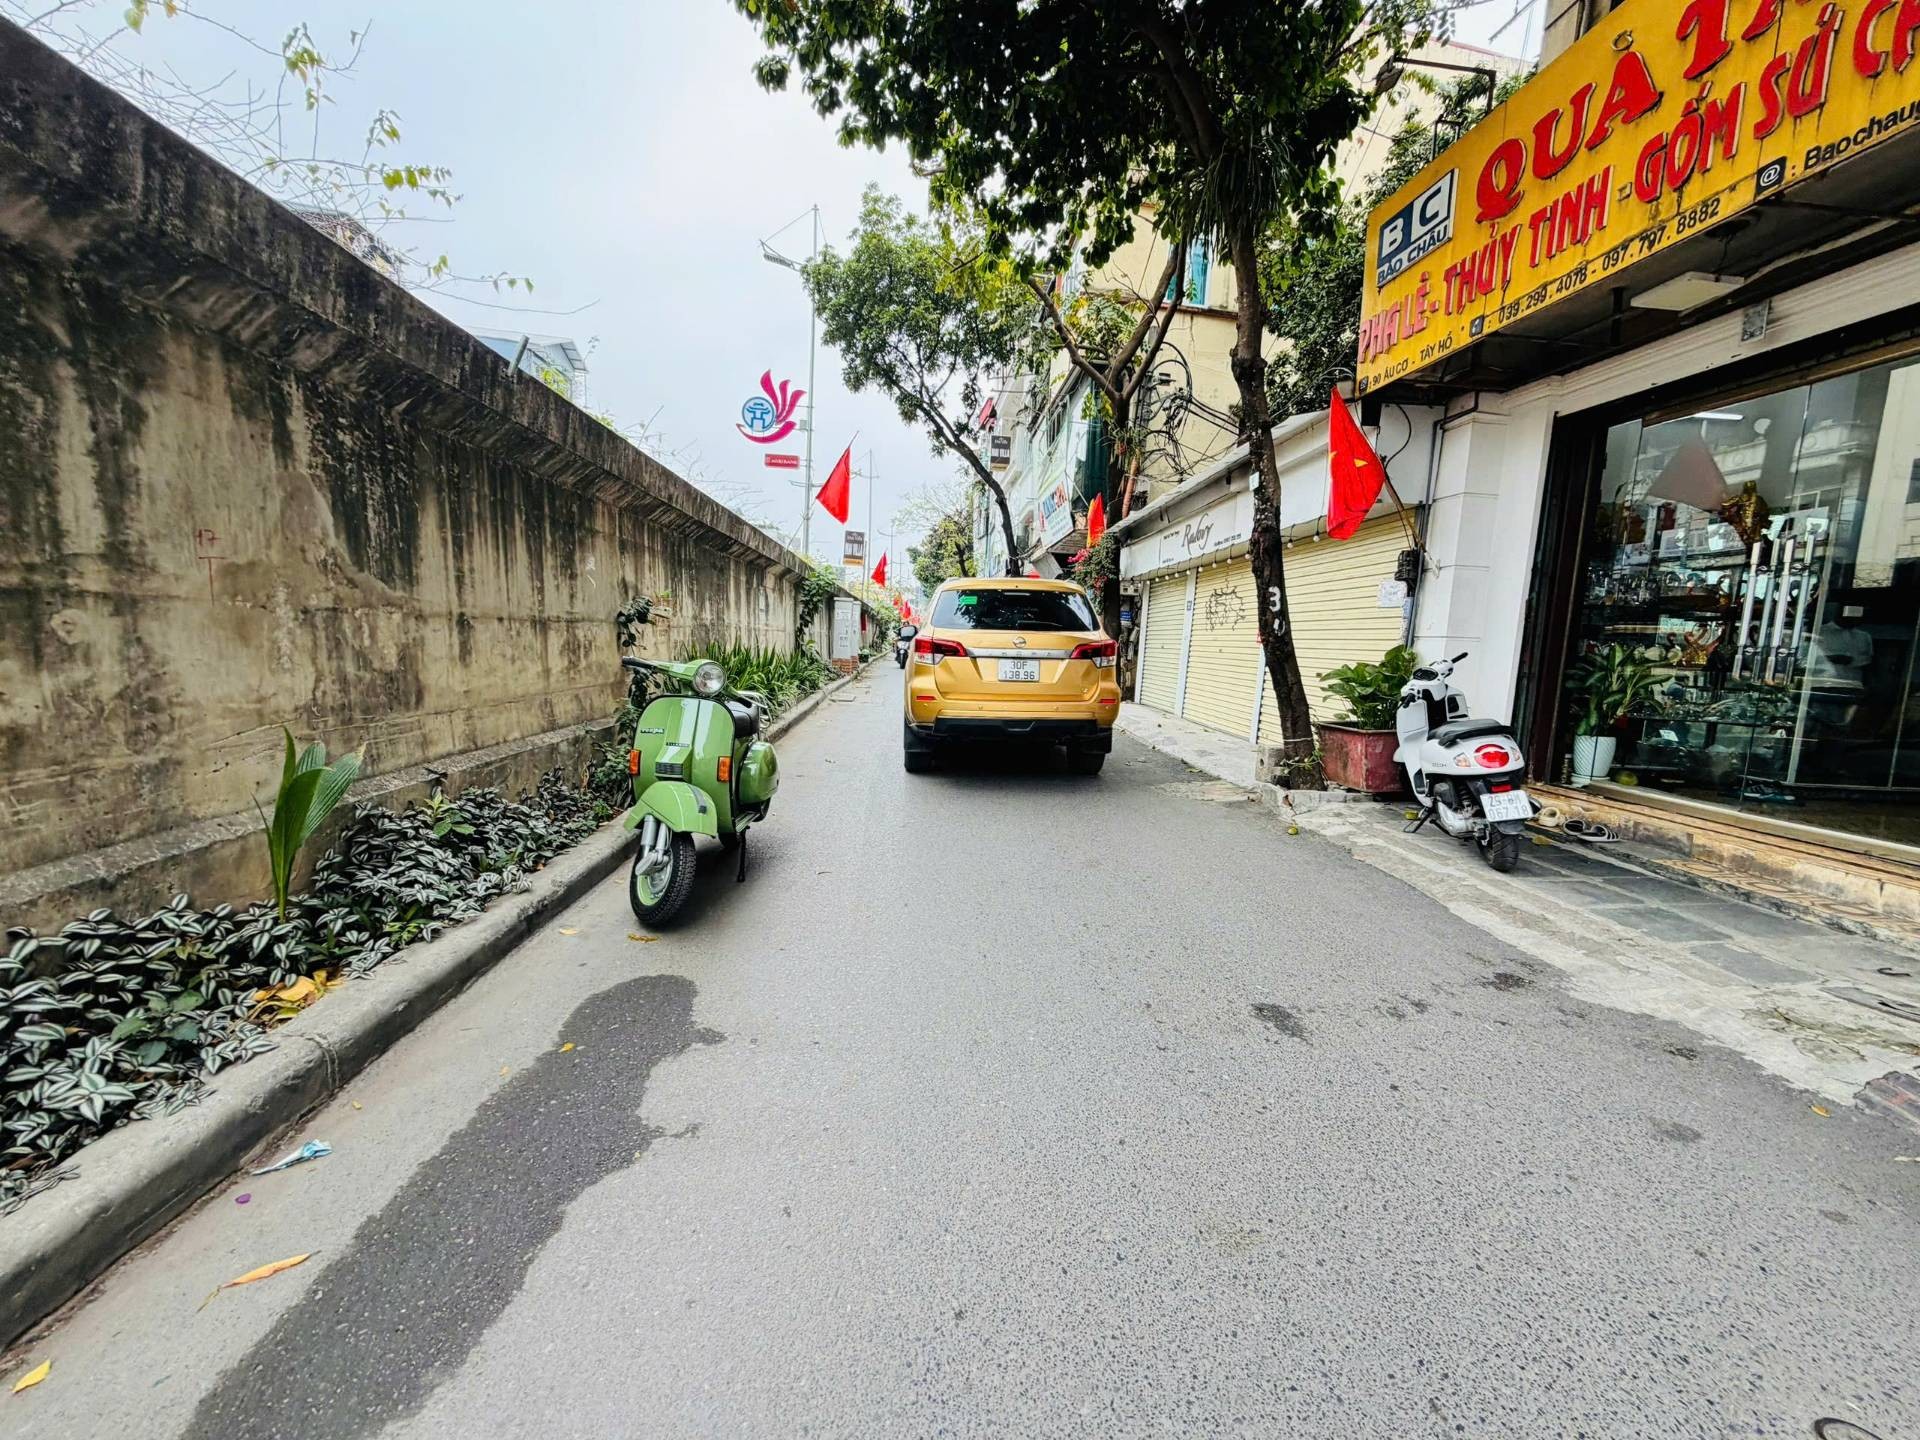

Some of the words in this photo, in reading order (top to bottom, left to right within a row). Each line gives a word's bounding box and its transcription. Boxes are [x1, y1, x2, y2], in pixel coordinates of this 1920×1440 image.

[1359, 300, 1400, 364] PHA
[1529, 165, 1614, 268] TINH
[1635, 80, 1747, 203] GỐM
[1754, 2, 1845, 139] SỨ
[1407, 225, 1448, 263] CHÂU
[1010, 660, 1028, 670] 30F
